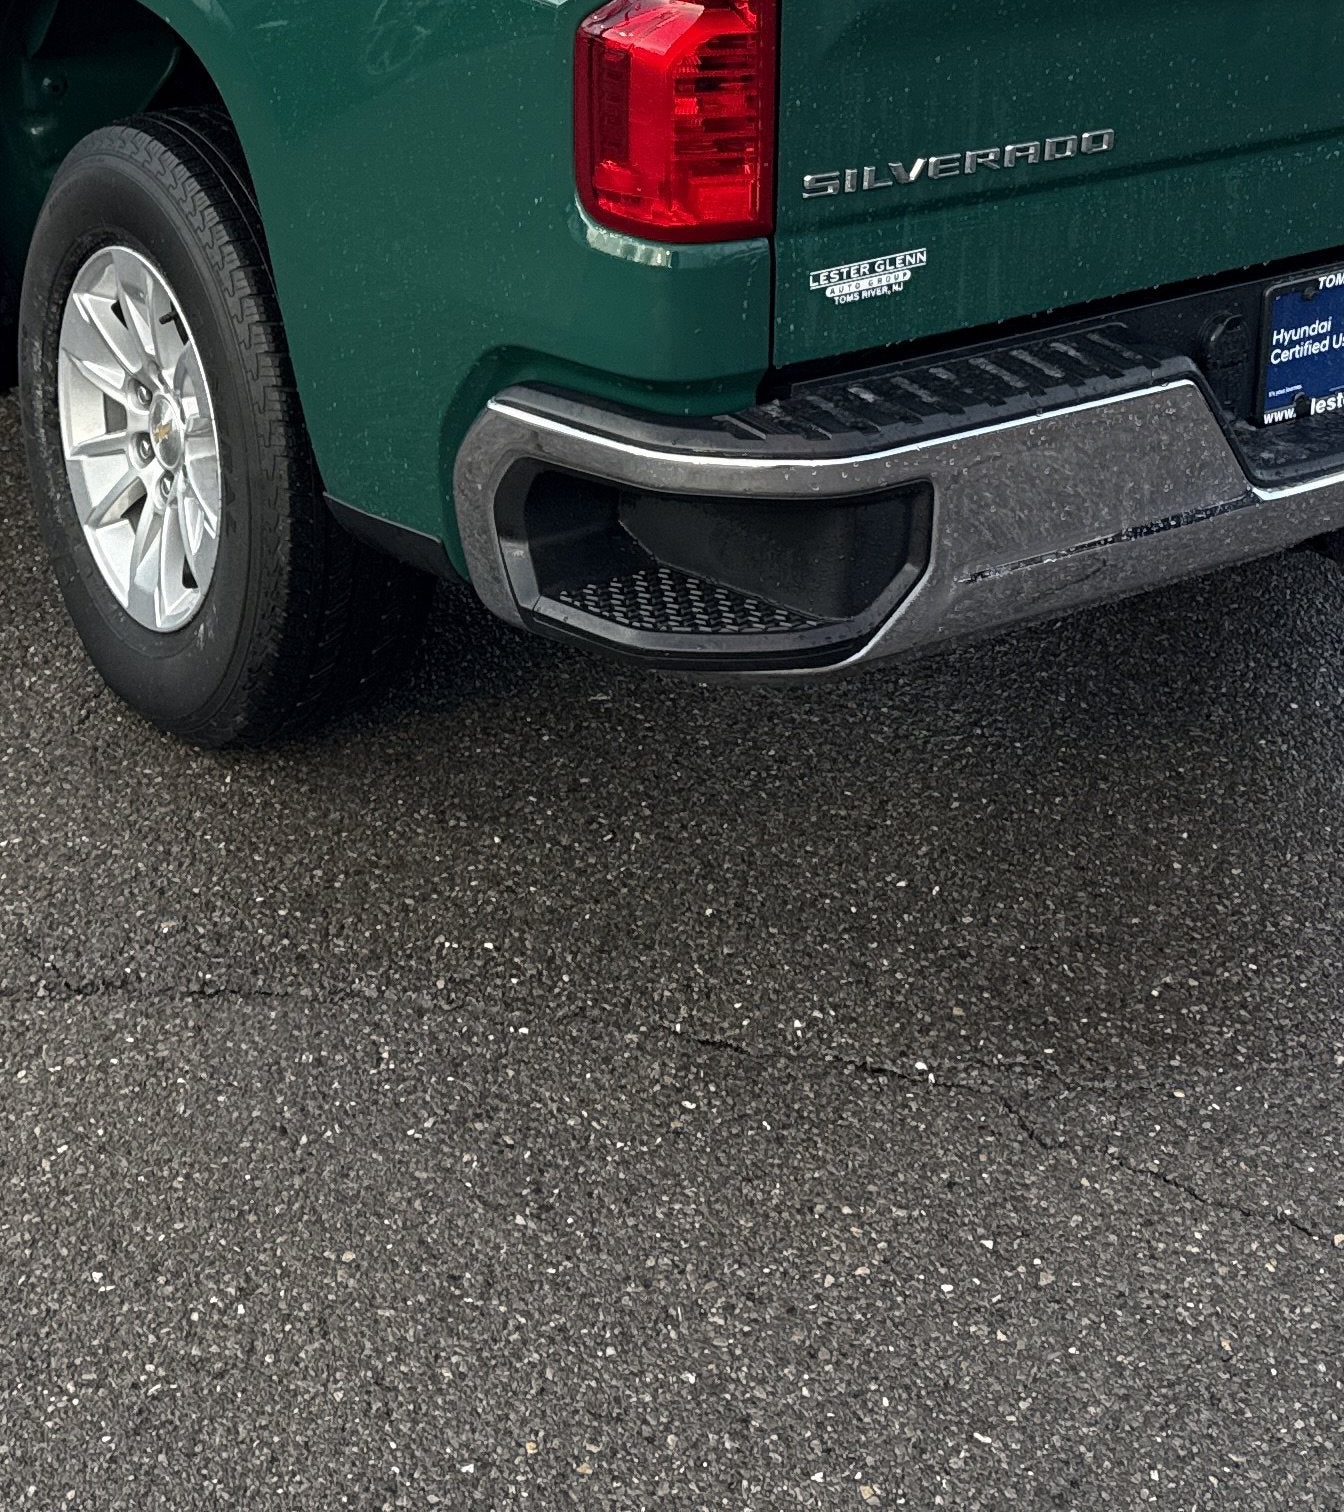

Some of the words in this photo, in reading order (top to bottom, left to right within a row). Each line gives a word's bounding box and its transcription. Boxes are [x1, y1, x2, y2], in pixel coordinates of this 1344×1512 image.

[803, 129, 1114, 198] SILVERADO
[810, 264, 870, 287] LESTER
[874, 250, 927, 273] GLENN
[829, 282, 861, 295] AUTO
[868, 271, 908, 287] GROUP
[834, 291, 860, 305] TOMS
[892, 282, 904, 293] NJ
[1272, 316, 1333, 346] Hyundai
[1270, 336, 1330, 365] Certified
